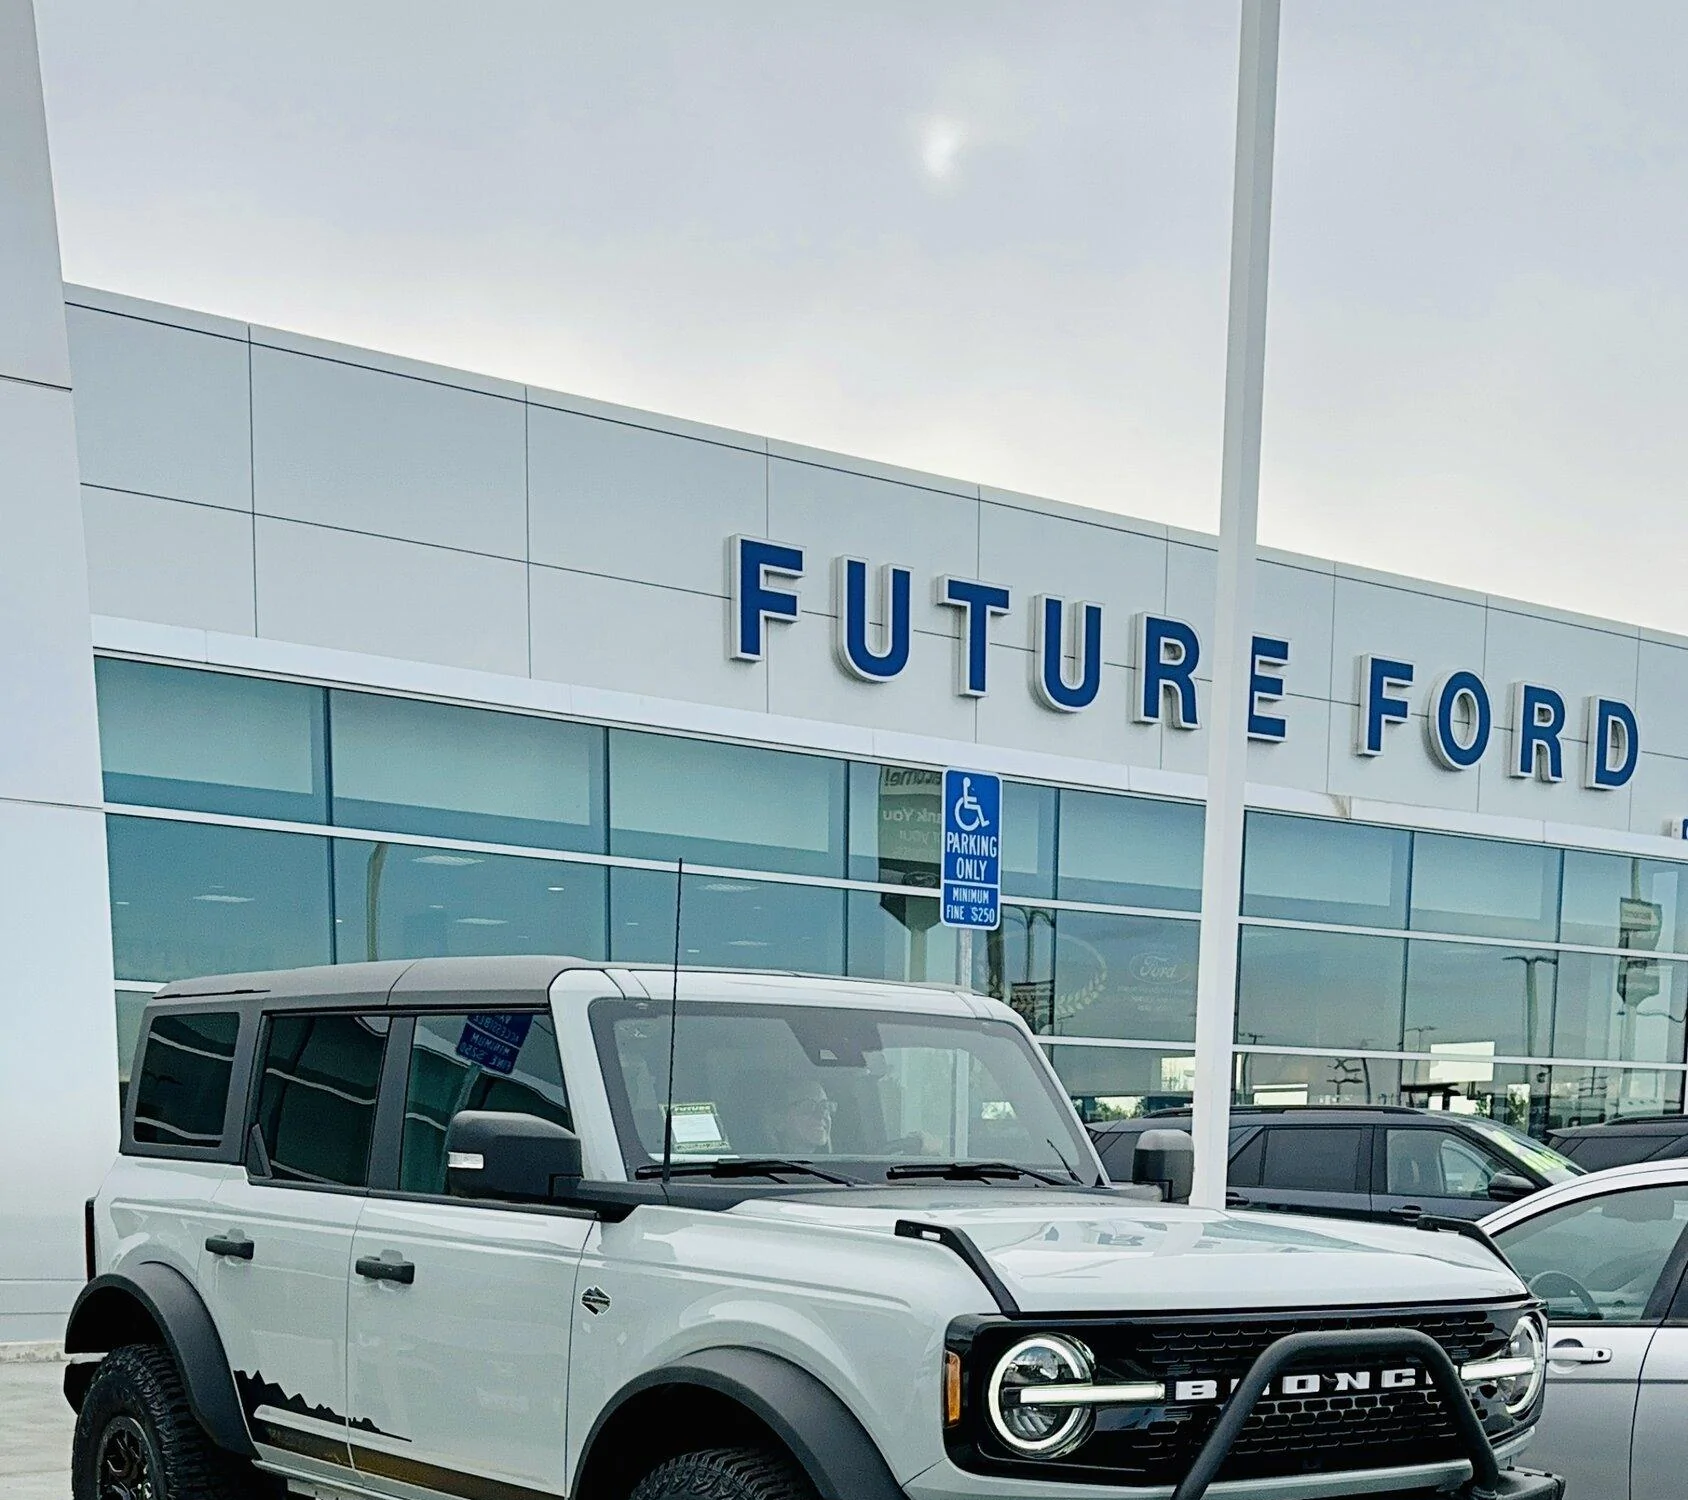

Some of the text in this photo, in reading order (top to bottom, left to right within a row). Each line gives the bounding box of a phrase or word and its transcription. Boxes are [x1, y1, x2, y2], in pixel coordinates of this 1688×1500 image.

[732, 534, 1641, 790] FUTURE FORD
[946, 832, 997, 858] PARKING
[956, 857, 988, 881] ONLY
[952, 887, 989, 904] MINIMUM
[946, 904, 995, 923] FINE $250
[1139, 955, 1178, 979] Ford
[1175, 1367, 1458, 1401] BONC
